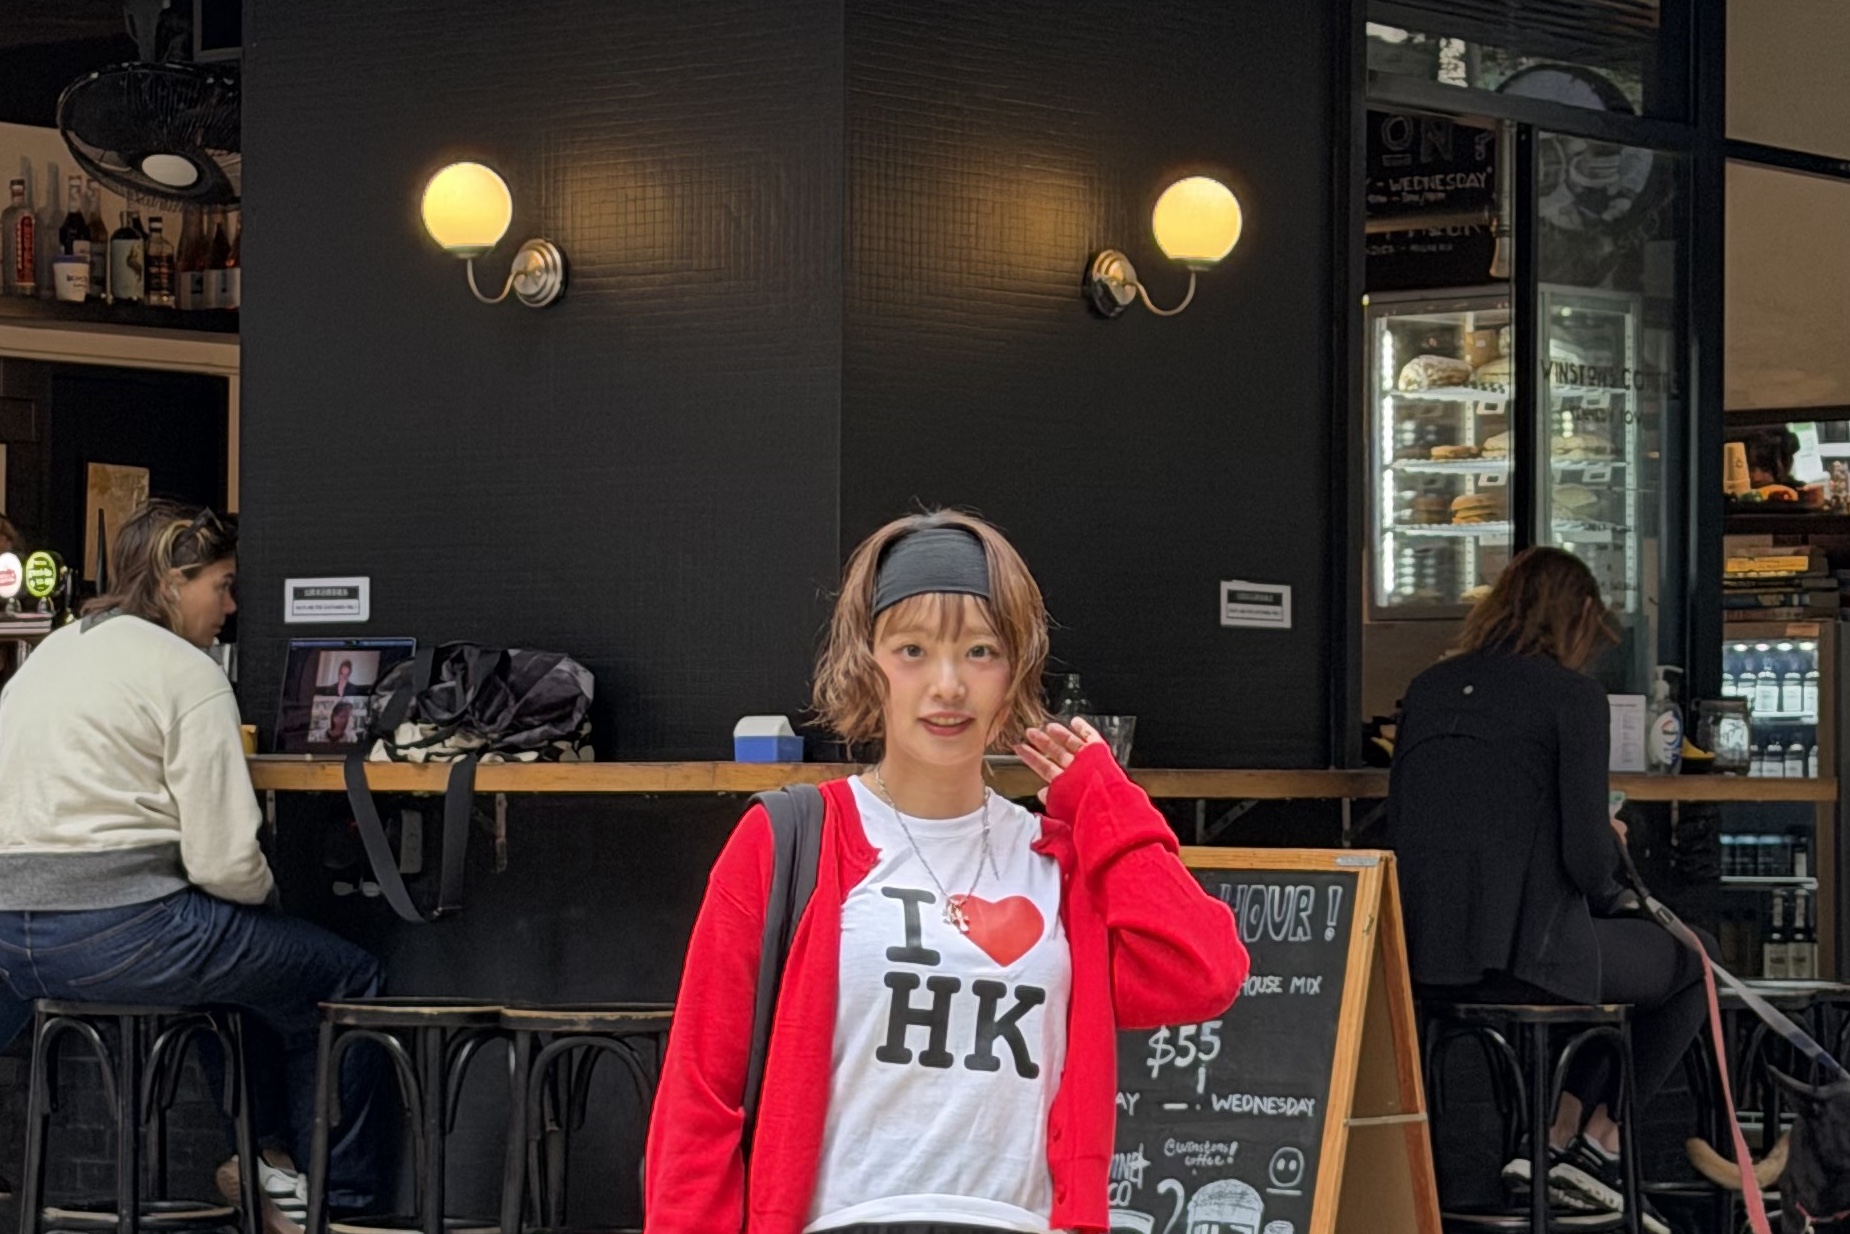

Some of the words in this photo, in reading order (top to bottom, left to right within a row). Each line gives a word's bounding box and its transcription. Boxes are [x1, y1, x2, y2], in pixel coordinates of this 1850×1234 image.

[1389, 172, 1487, 191] WEDNESDAY
[881, 886, 941, 967] I
[1289, 975, 1323, 996] MIX
[875, 970, 1046, 1080] HK
[1211, 1093, 1315, 1117] WEDNESDAY
